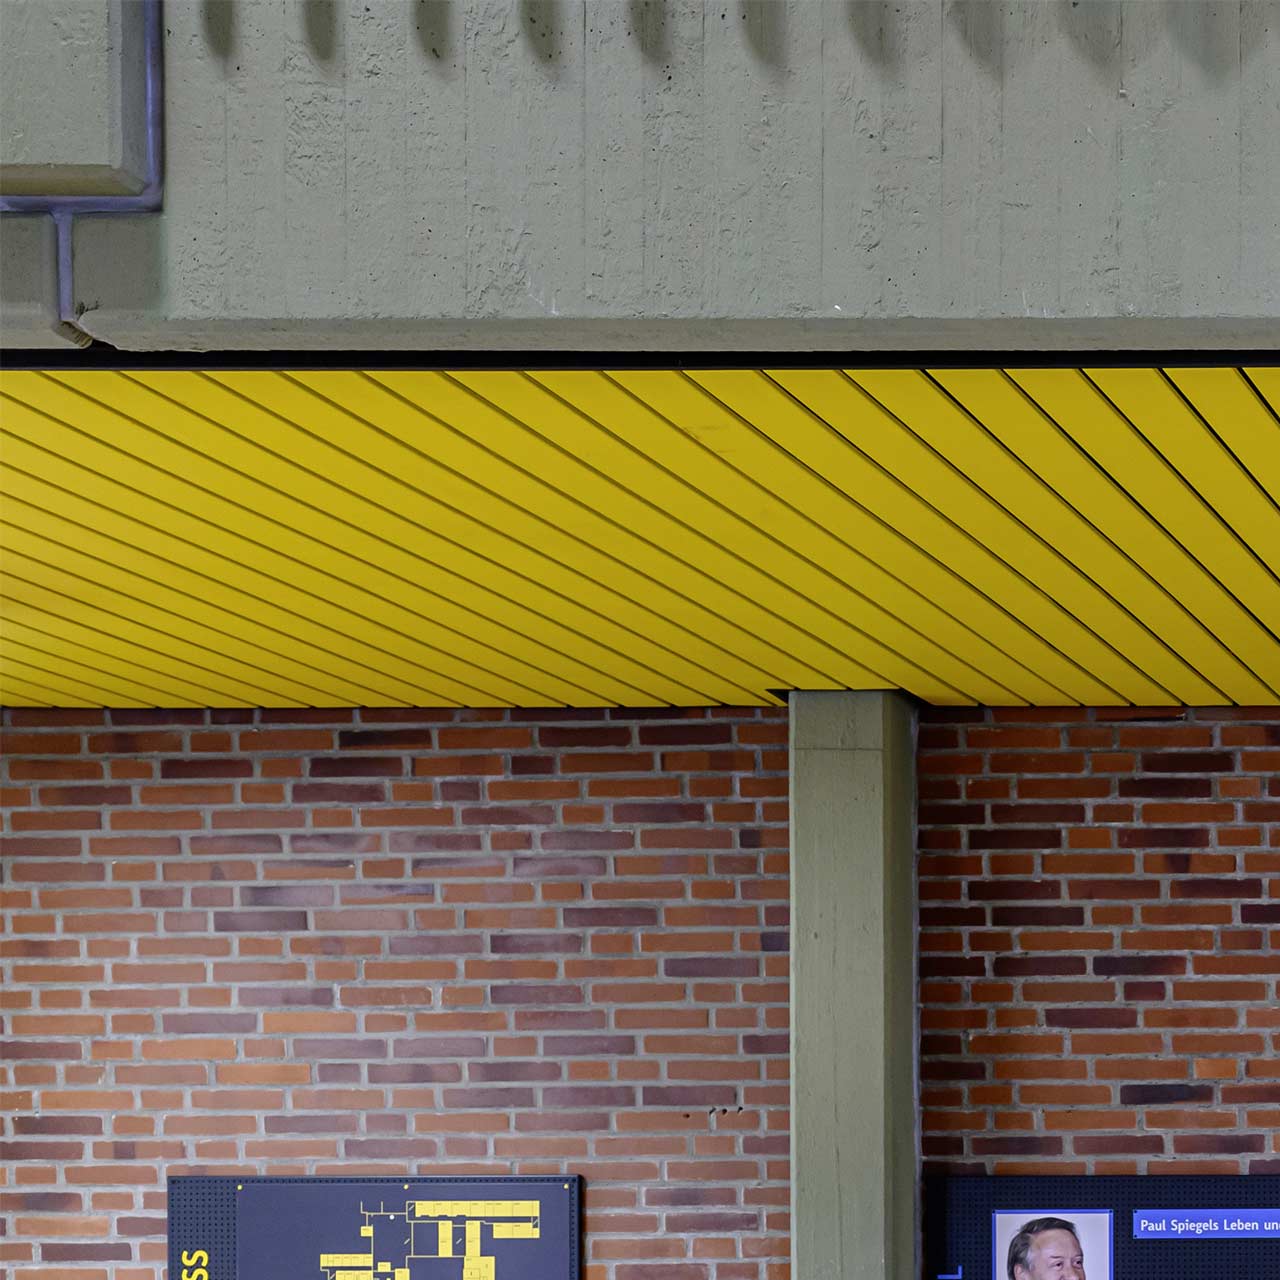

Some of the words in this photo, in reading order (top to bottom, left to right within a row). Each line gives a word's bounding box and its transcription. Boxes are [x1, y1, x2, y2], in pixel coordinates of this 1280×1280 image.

[1140, 1219, 1166, 1231] Paul
[1170, 1219, 1219, 1234] Spiegels
[1223, 1219, 1259, 1231] Leben
